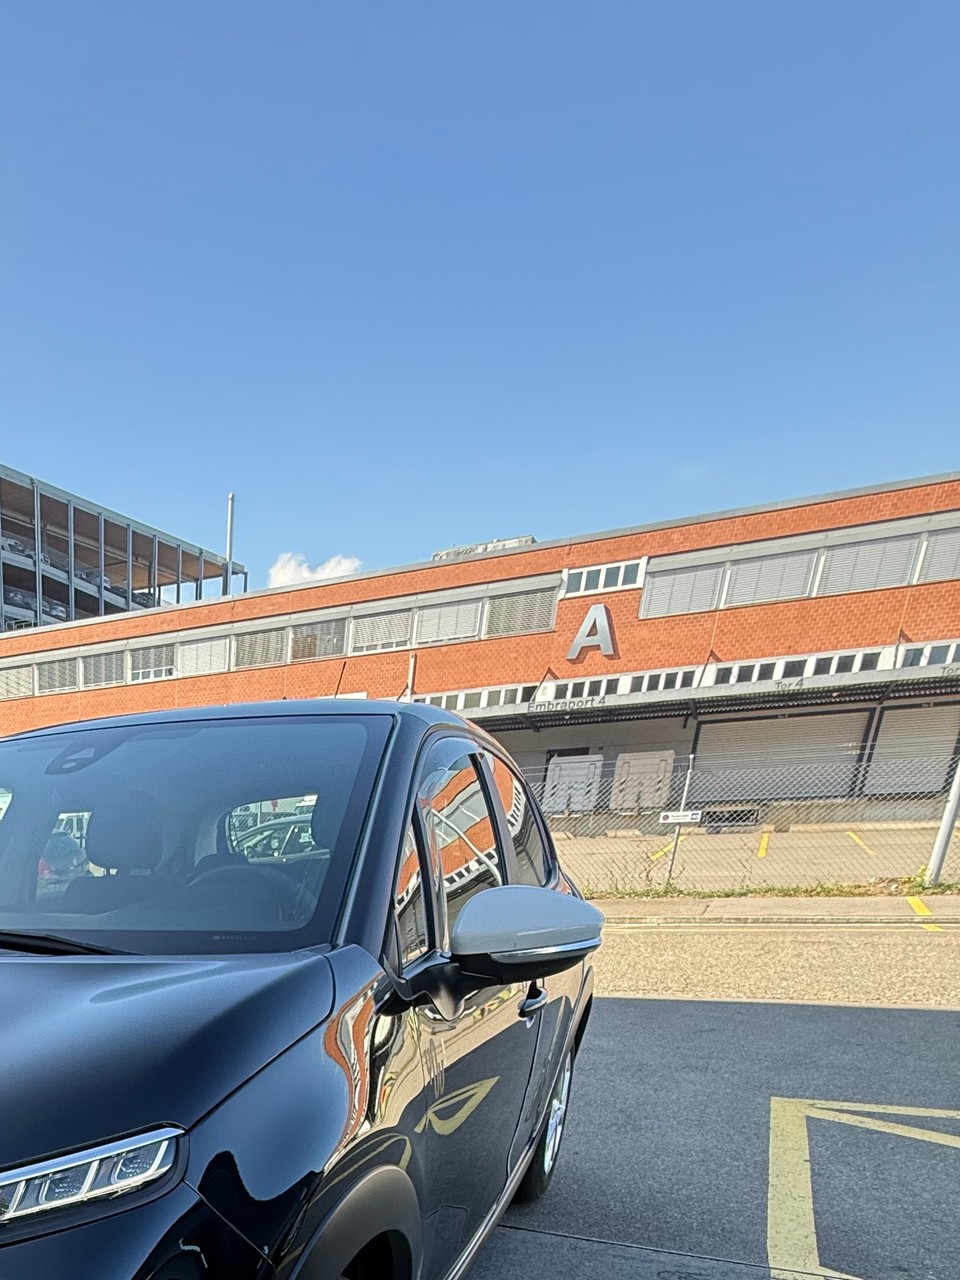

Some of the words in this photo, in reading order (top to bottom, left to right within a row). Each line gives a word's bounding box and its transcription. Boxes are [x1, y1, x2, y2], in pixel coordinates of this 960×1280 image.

[566, 603, 614, 660] A
[775, 681, 793, 690] Tor
[795, 677, 805, 689] 4
[527, 698, 595, 712] Embraport
[598, 695, 607, 705] 4
